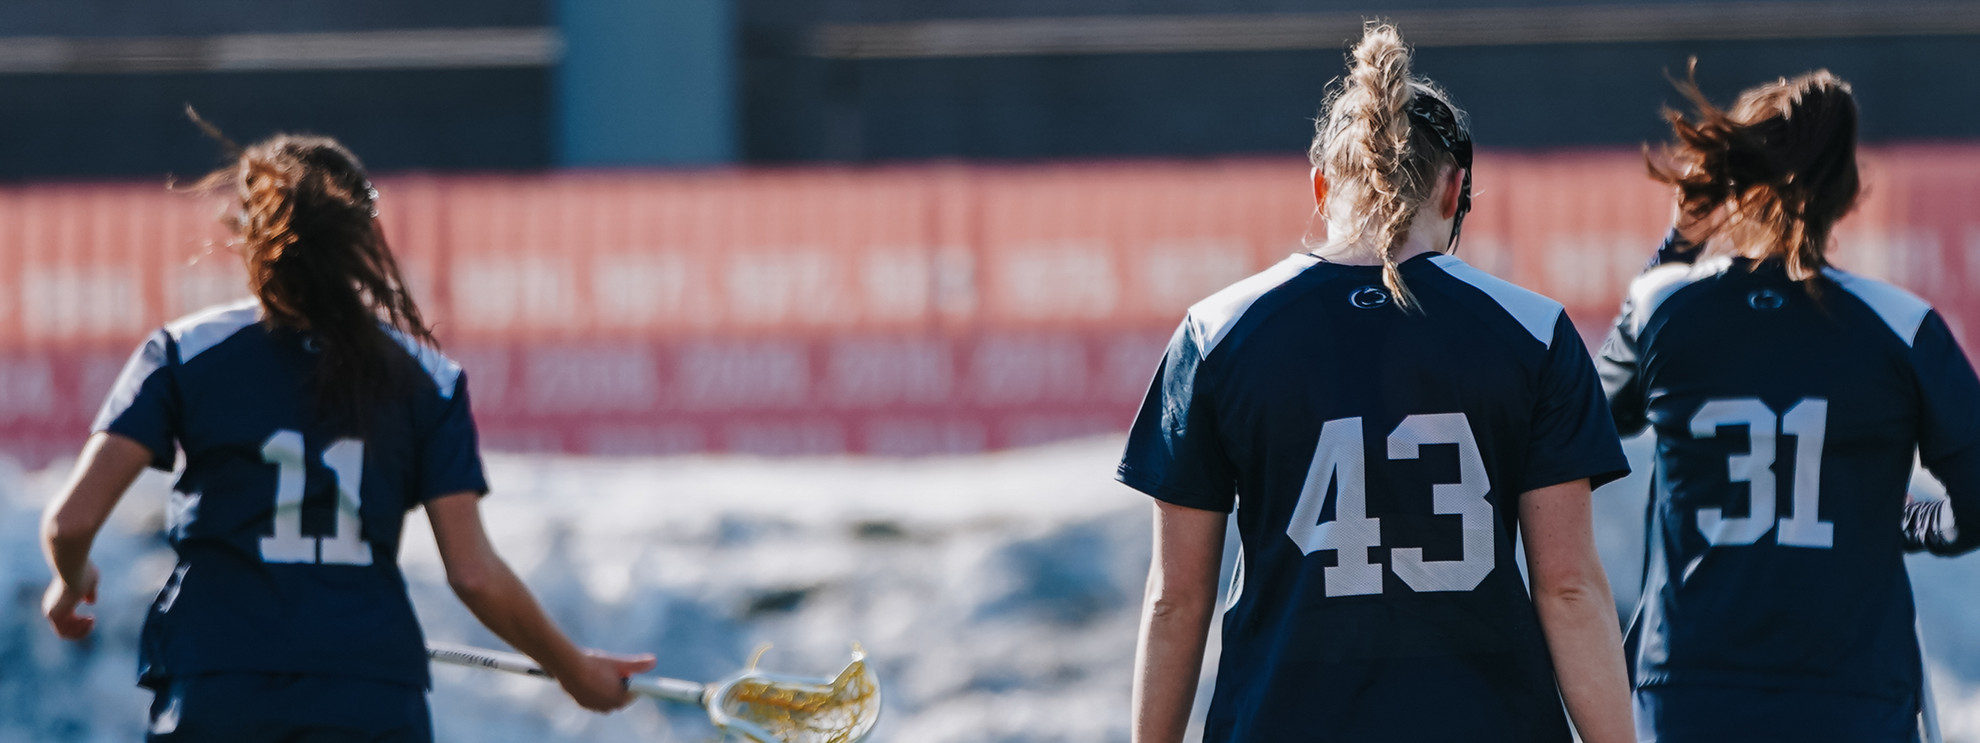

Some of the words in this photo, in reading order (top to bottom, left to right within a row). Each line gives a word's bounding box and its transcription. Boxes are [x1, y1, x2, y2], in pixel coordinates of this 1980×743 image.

[259, 429, 373, 566] 11
[1286, 412, 1495, 597] 43
[1689, 398, 1834, 548] 31
